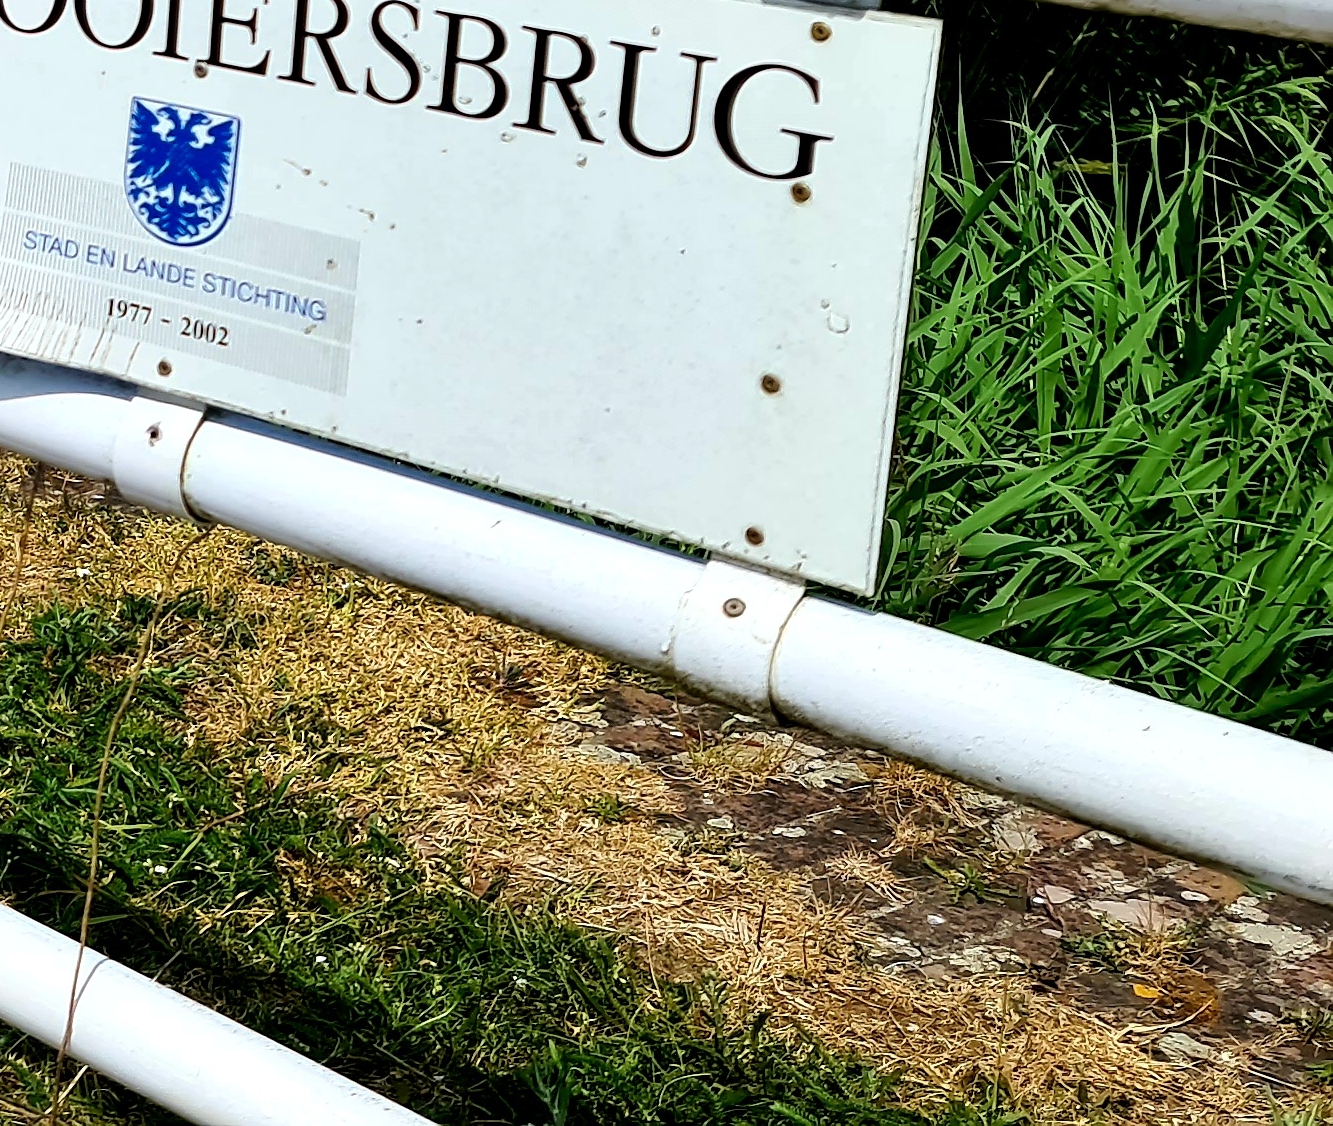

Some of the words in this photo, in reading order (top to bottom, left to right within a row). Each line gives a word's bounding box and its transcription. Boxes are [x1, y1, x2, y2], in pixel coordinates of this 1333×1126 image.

[23, 230, 79, 259] STAD
[86, 247, 116, 269] EN
[123, 253, 196, 289] LANDE
[201, 273, 328, 323] STICHTING
[107, 297, 153, 326] 1977
[180, 316, 230, 348] 2002
